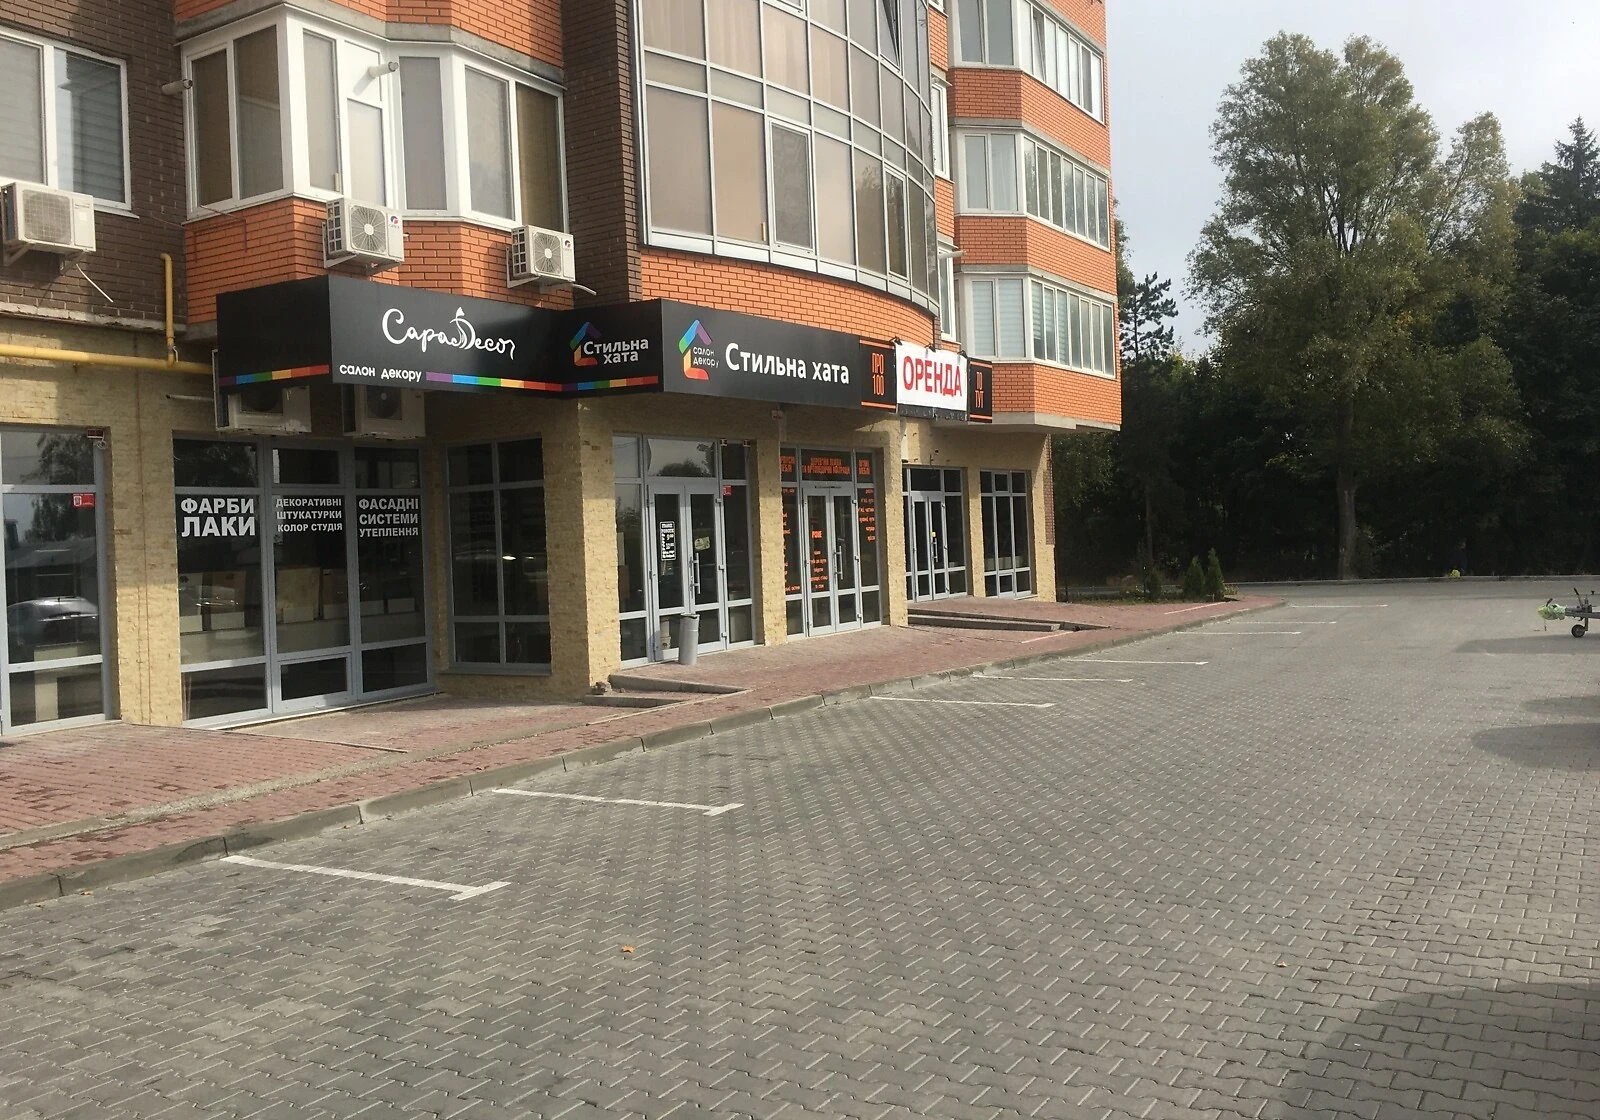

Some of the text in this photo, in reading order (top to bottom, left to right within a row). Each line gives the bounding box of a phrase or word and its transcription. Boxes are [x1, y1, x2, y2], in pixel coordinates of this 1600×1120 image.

[583, 338, 649, 355] Стильна
[692, 346, 715, 357] салон
[603, 350, 639, 365] хата
[692, 356, 720, 369] декору
[725, 342, 850, 385] Стильна хата
[871, 352, 885, 375] ПРО
[339, 364, 422, 383] салон декору
[902, 355, 963, 397] ОРЕНДА
[872, 374, 885, 396] 100
[180, 498, 255, 515] ФАРБИ
[275, 498, 342, 508] ДЕКОРАТИВНІ
[358, 498, 419, 511] ФАСАДНІ
[276, 510, 343, 520] ШТУКАТУРКИ
[358, 513, 419, 525] СИСТЕМИ
[181, 516, 256, 538] ЛАКИ
[277, 522, 343, 533] КОЛОР СТУДІЯ
[359, 526, 419, 538] УТЕПЛЕННЯ
